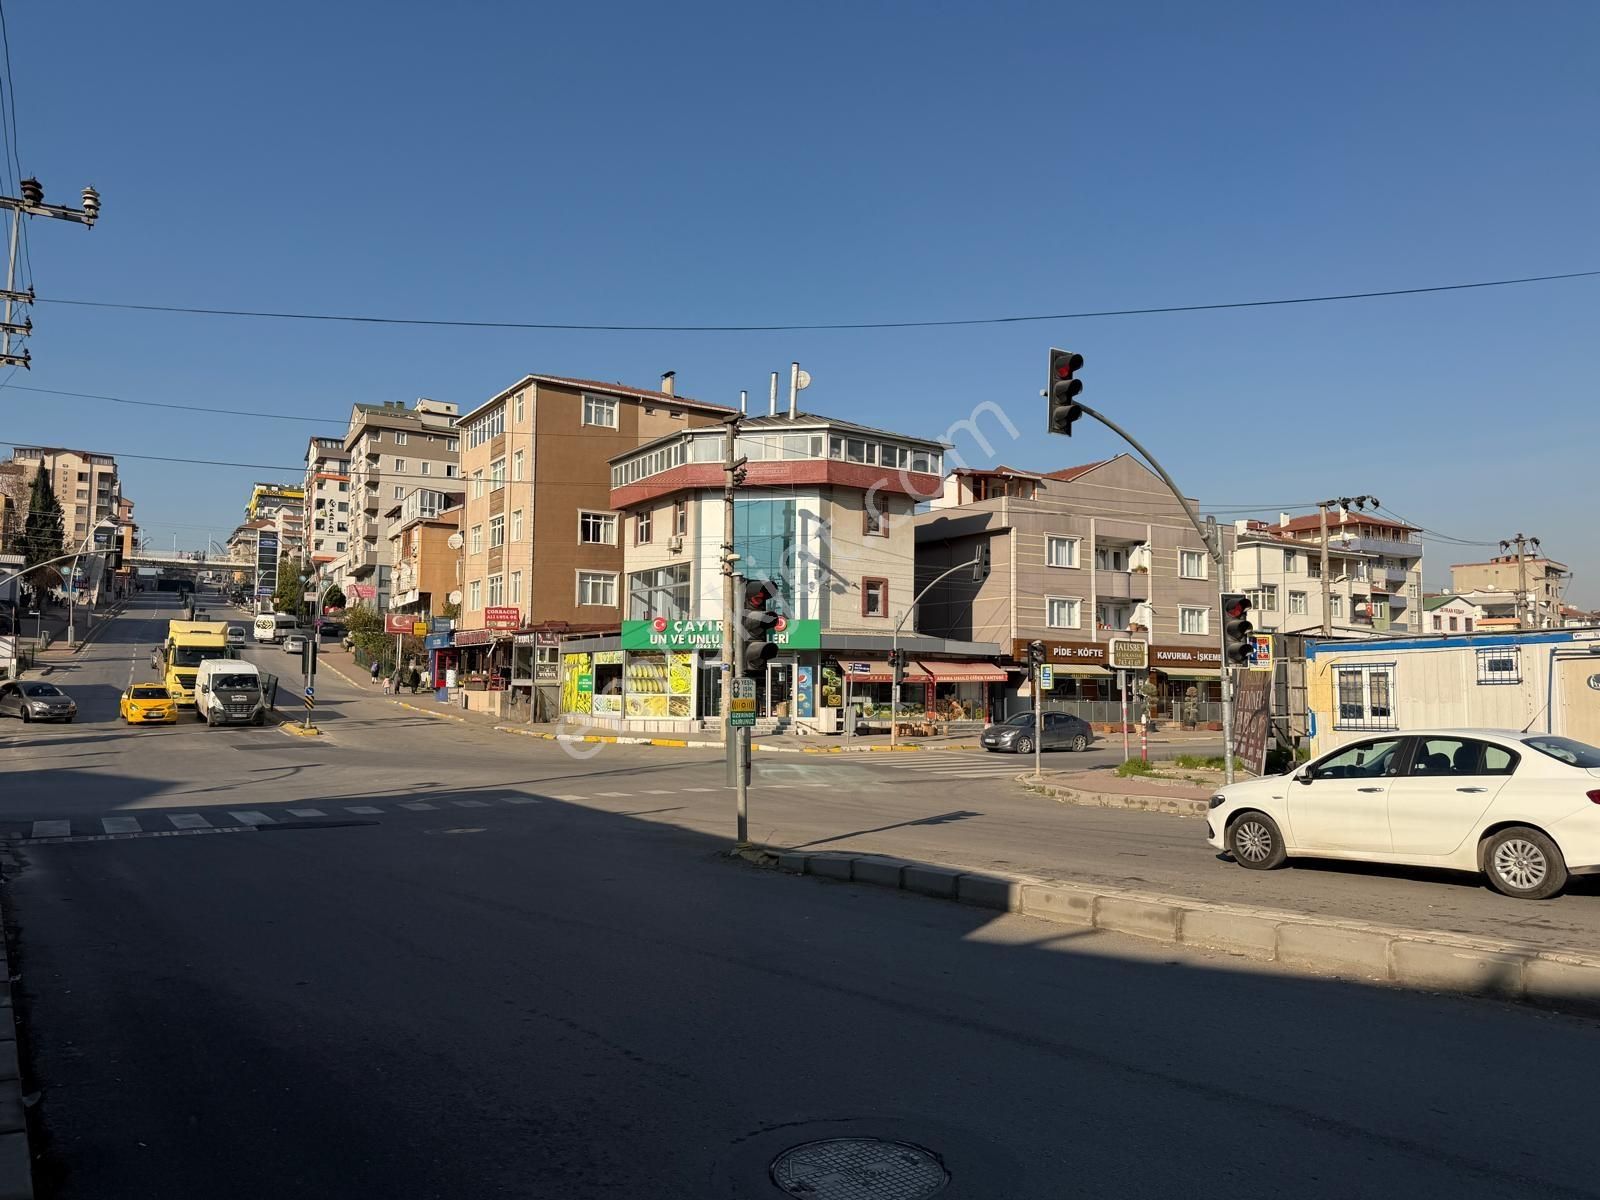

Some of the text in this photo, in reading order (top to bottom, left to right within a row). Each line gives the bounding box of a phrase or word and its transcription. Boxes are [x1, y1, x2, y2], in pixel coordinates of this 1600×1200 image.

[673, 620, 724, 633] ÇAYIR
[650, 631, 789, 645] UN VE UNLU LERİ
[1053, 645, 1072, 657] PİDE
[1077, 647, 1104, 658] KÖFTE
[1157, 651, 1192, 660] KAVURMA
